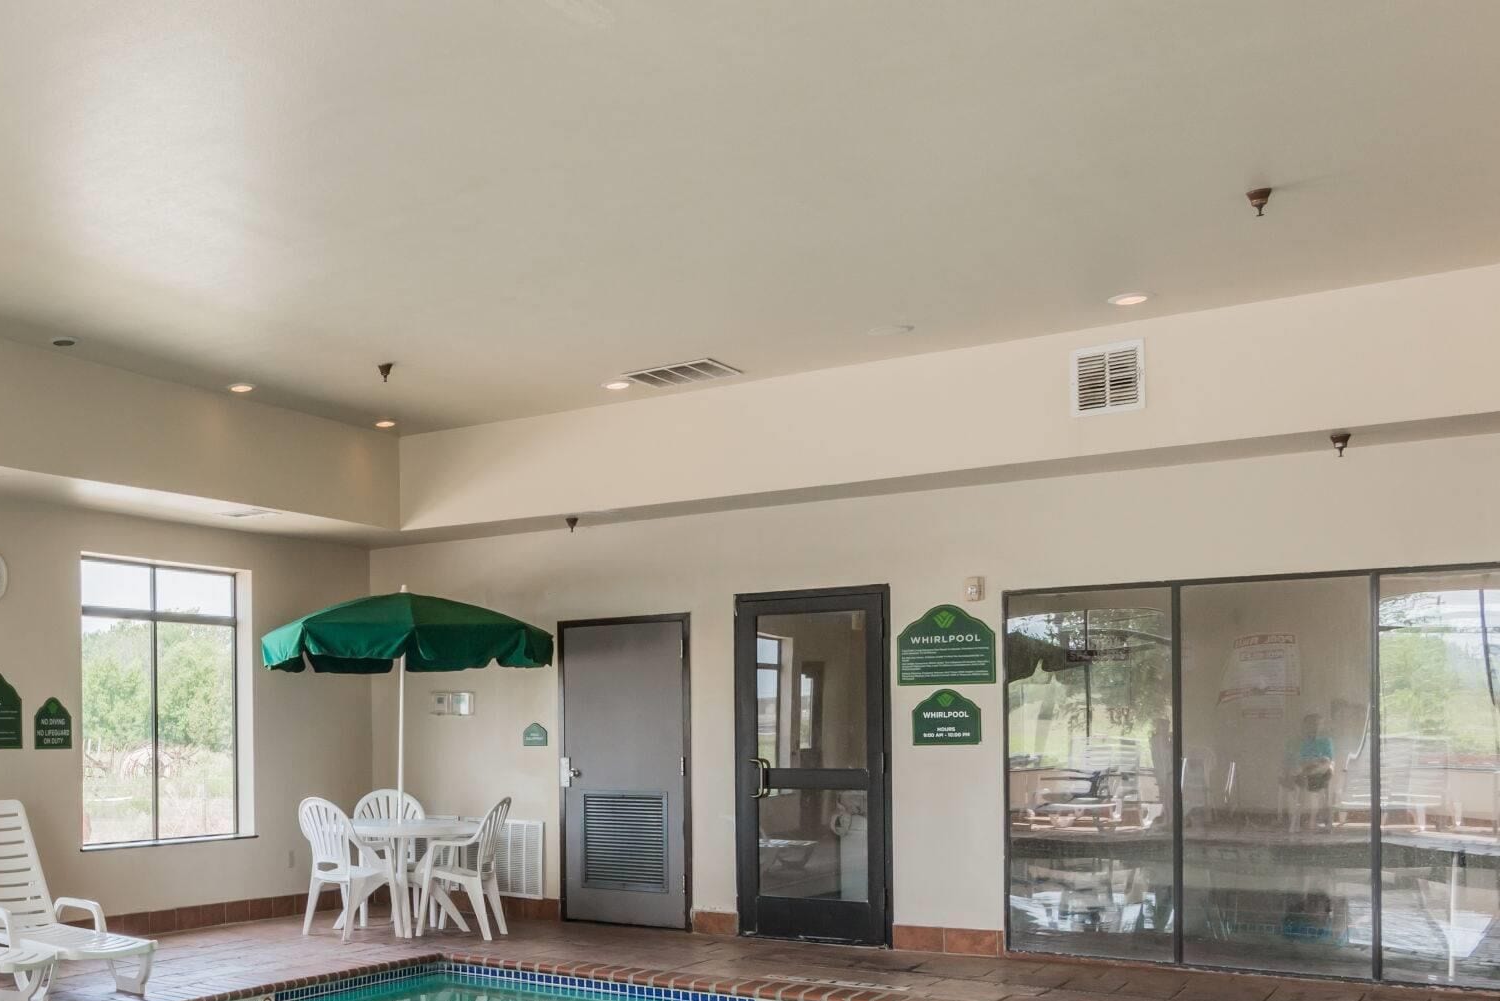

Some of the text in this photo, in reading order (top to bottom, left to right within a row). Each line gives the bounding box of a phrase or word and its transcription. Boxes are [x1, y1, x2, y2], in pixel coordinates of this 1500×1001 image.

[910, 634, 981, 644] WHIRLPOOL
[922, 711, 970, 719] WHIRLPOOL
[43, 737, 64, 745] ON DUTY
